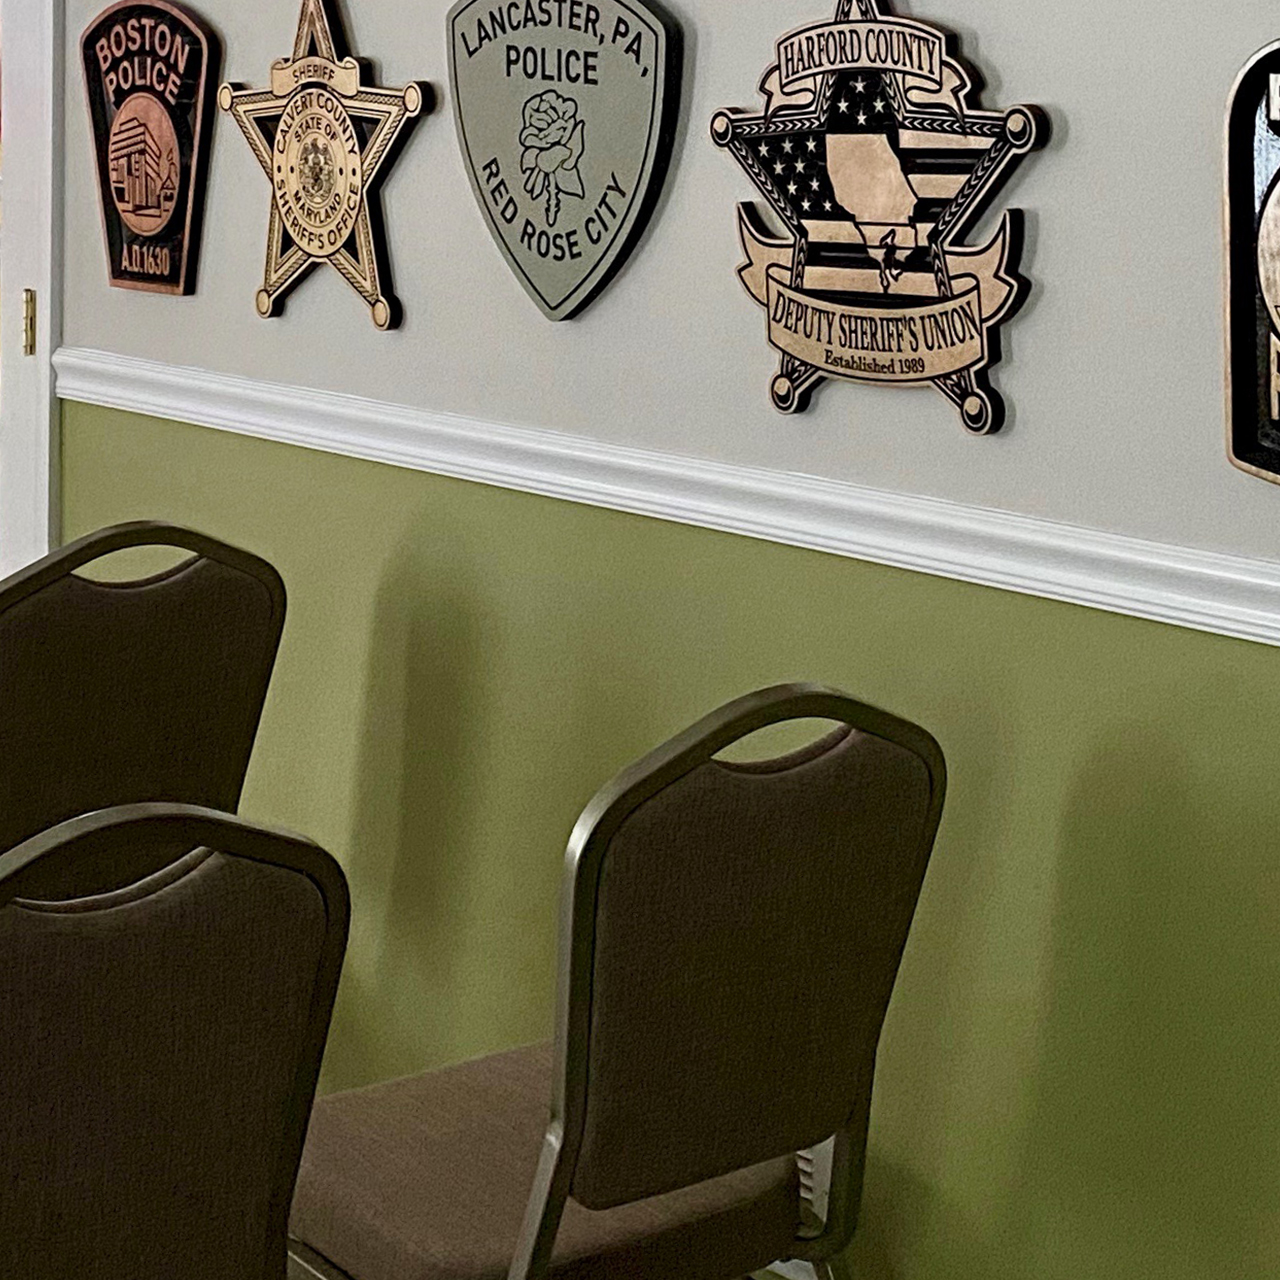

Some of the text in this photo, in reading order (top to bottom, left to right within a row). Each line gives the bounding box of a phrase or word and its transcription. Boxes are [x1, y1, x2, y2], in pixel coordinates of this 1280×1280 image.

[96, 18, 190, 73] BOSTON
[506, 44, 599, 86] POLICE
[782, 27, 939, 81] HARFORD COUNTY
[105, 56, 181, 106] POLICE
[292, 64, 335, 83] SHERIFF
[276, 92, 358, 155] CALVERT COUNTY
[294, 116, 339, 143] STATE OF
[276, 179, 360, 249] SHERIFF'S OFFICE
[293, 189, 341, 223] MARYLAND
[482, 157, 628, 262] RED ROSE CITY
[771, 290, 981, 353] DEPUTY SHERIFF'S UNION
[824, 348, 925, 374] Established 1989
